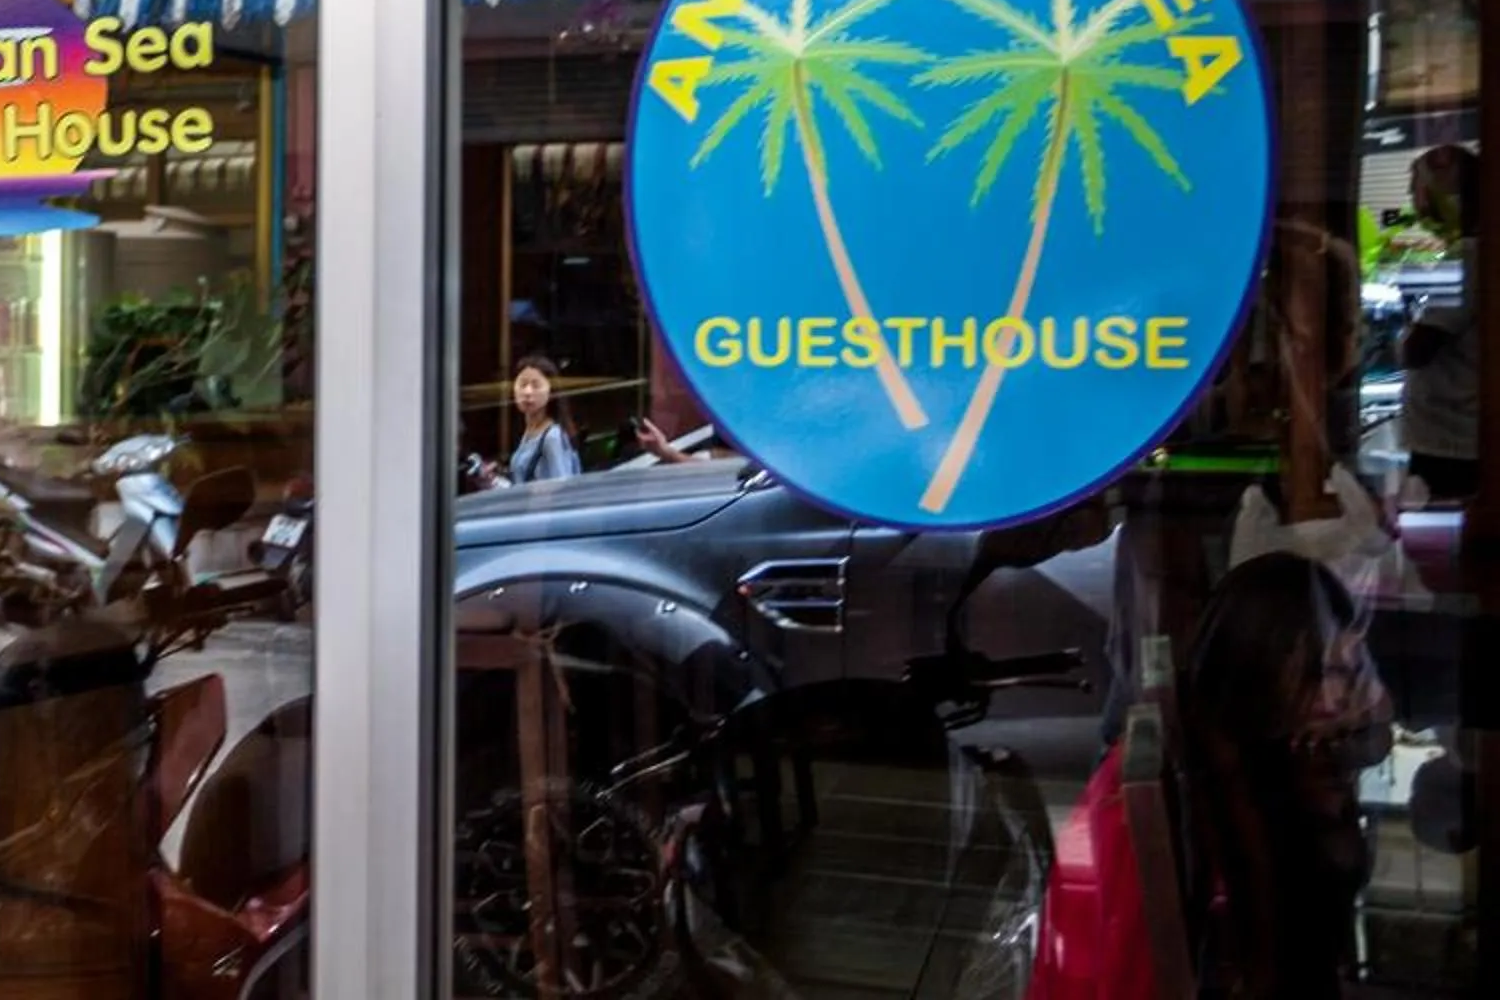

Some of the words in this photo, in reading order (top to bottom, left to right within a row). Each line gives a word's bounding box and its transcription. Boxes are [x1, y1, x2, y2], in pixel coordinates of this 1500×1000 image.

[83, 16, 214, 78] Sea
[4, 102, 214, 162] House
[693, 315, 1192, 369] GUESTHOUSE
